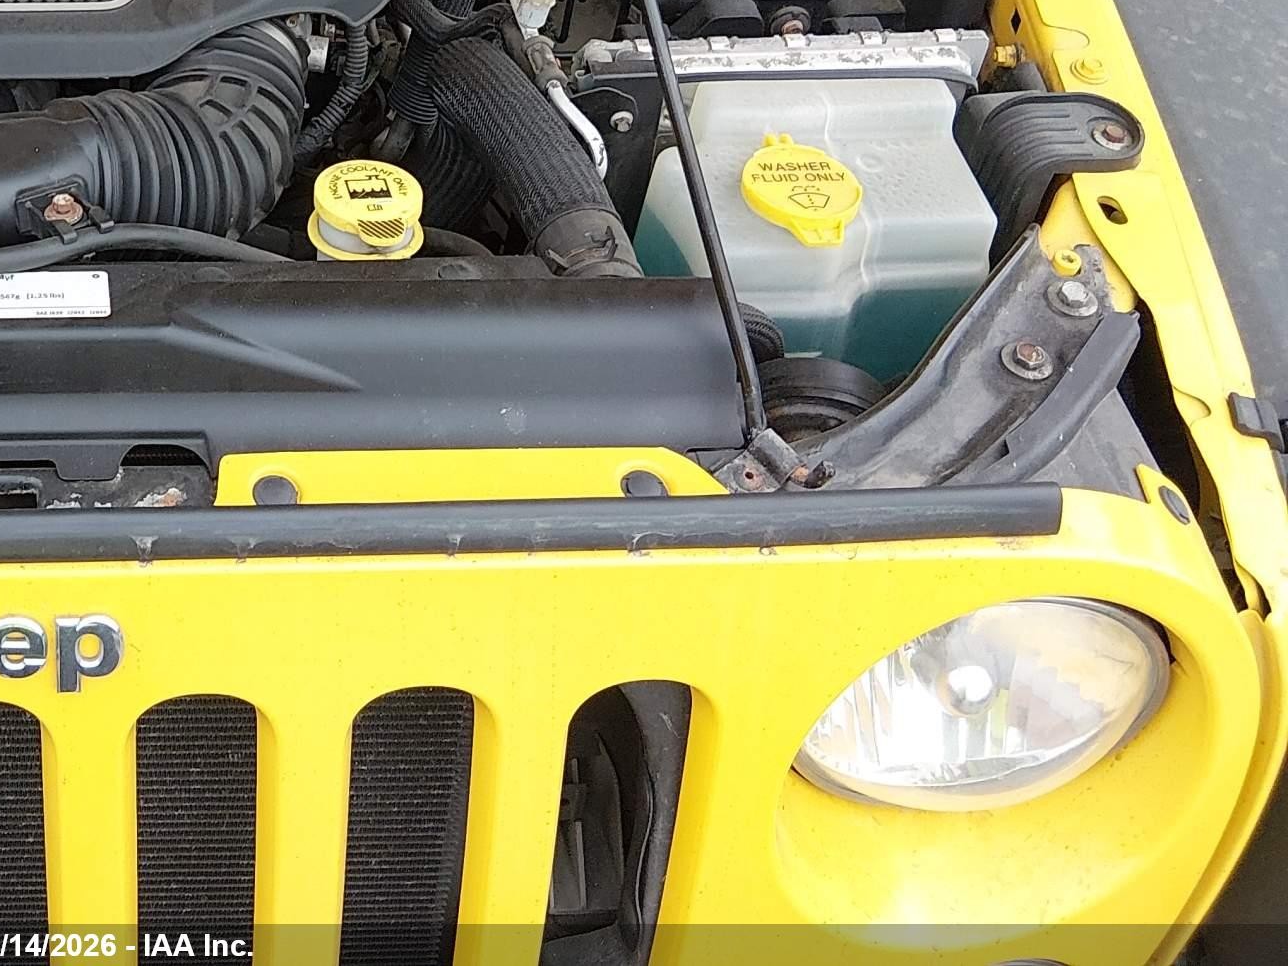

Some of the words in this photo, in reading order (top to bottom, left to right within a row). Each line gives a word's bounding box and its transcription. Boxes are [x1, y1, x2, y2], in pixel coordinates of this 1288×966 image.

[757, 161, 831, 172] WASHER
[340, 165, 394, 177] COOLANT
[392, 177, 409, 196] ONLY
[750, 172, 800, 183] FLUID
[805, 171, 846, 182] ONLY
